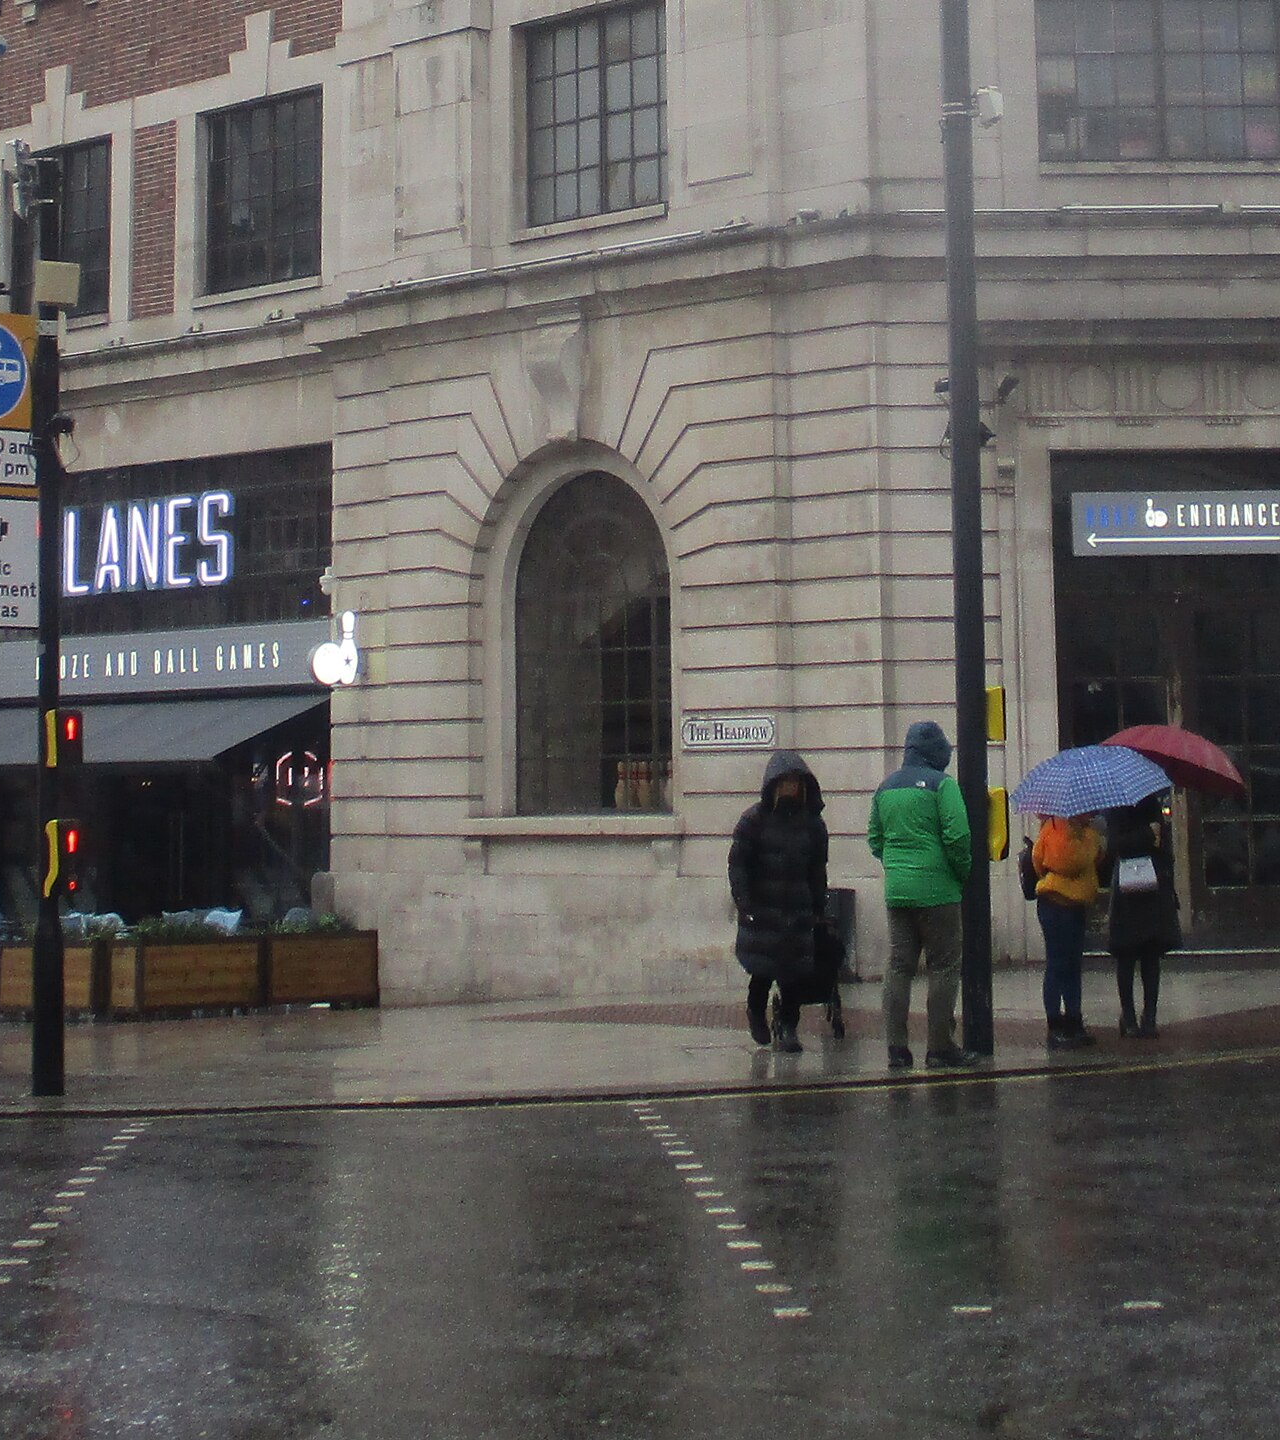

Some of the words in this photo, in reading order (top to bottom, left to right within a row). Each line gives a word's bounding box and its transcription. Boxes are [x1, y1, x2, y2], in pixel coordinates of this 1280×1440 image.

[4, 462, 30, 478] pm
[1176, 502, 1280, 528] ENTRANCE
[62, 490, 235, 598] LANES
[105, 650, 139, 677] AND
[153, 646, 200, 676] BALL
[215, 640, 281, 672] GAMES
